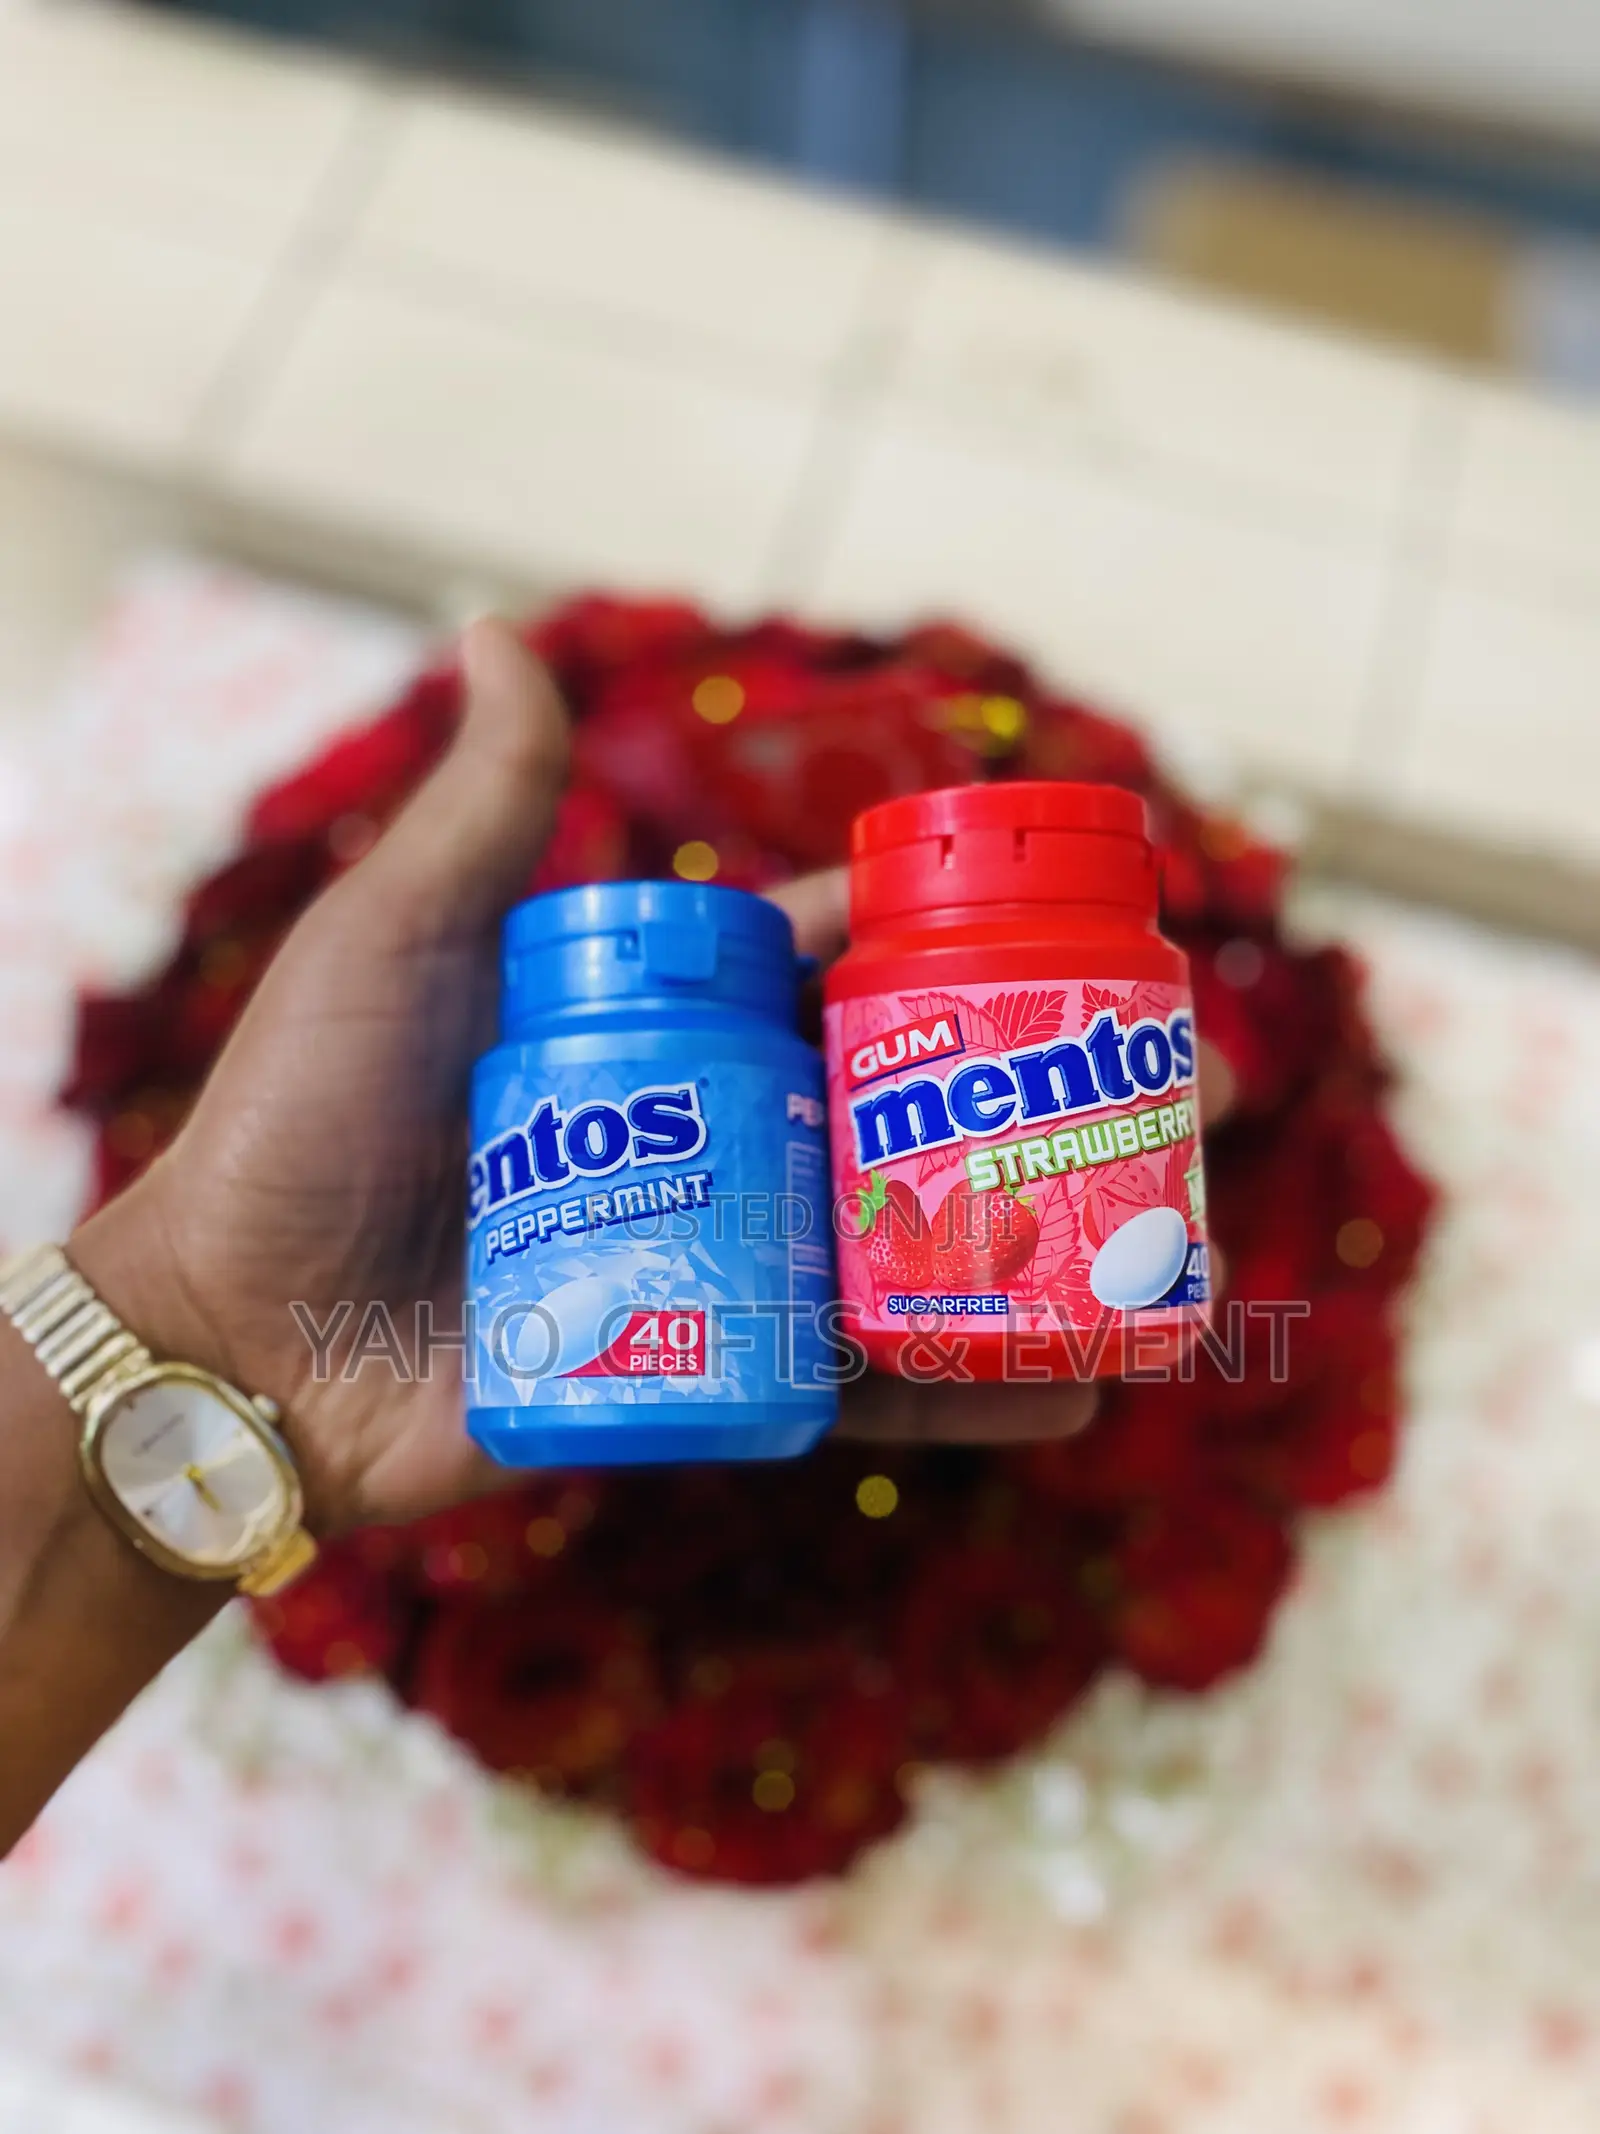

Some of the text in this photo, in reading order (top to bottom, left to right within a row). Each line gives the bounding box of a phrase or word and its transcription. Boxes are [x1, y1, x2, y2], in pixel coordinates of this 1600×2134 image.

[850, 1020, 956, 1078] GUM
[850, 1008, 1196, 1170] mentos
[484, 1171, 711, 1263] PEPPERMINT
[888, 1295, 1007, 1313] SUGARFREE
[629, 1316, 699, 1349] 40
[629, 1352, 698, 1372] PIECES
